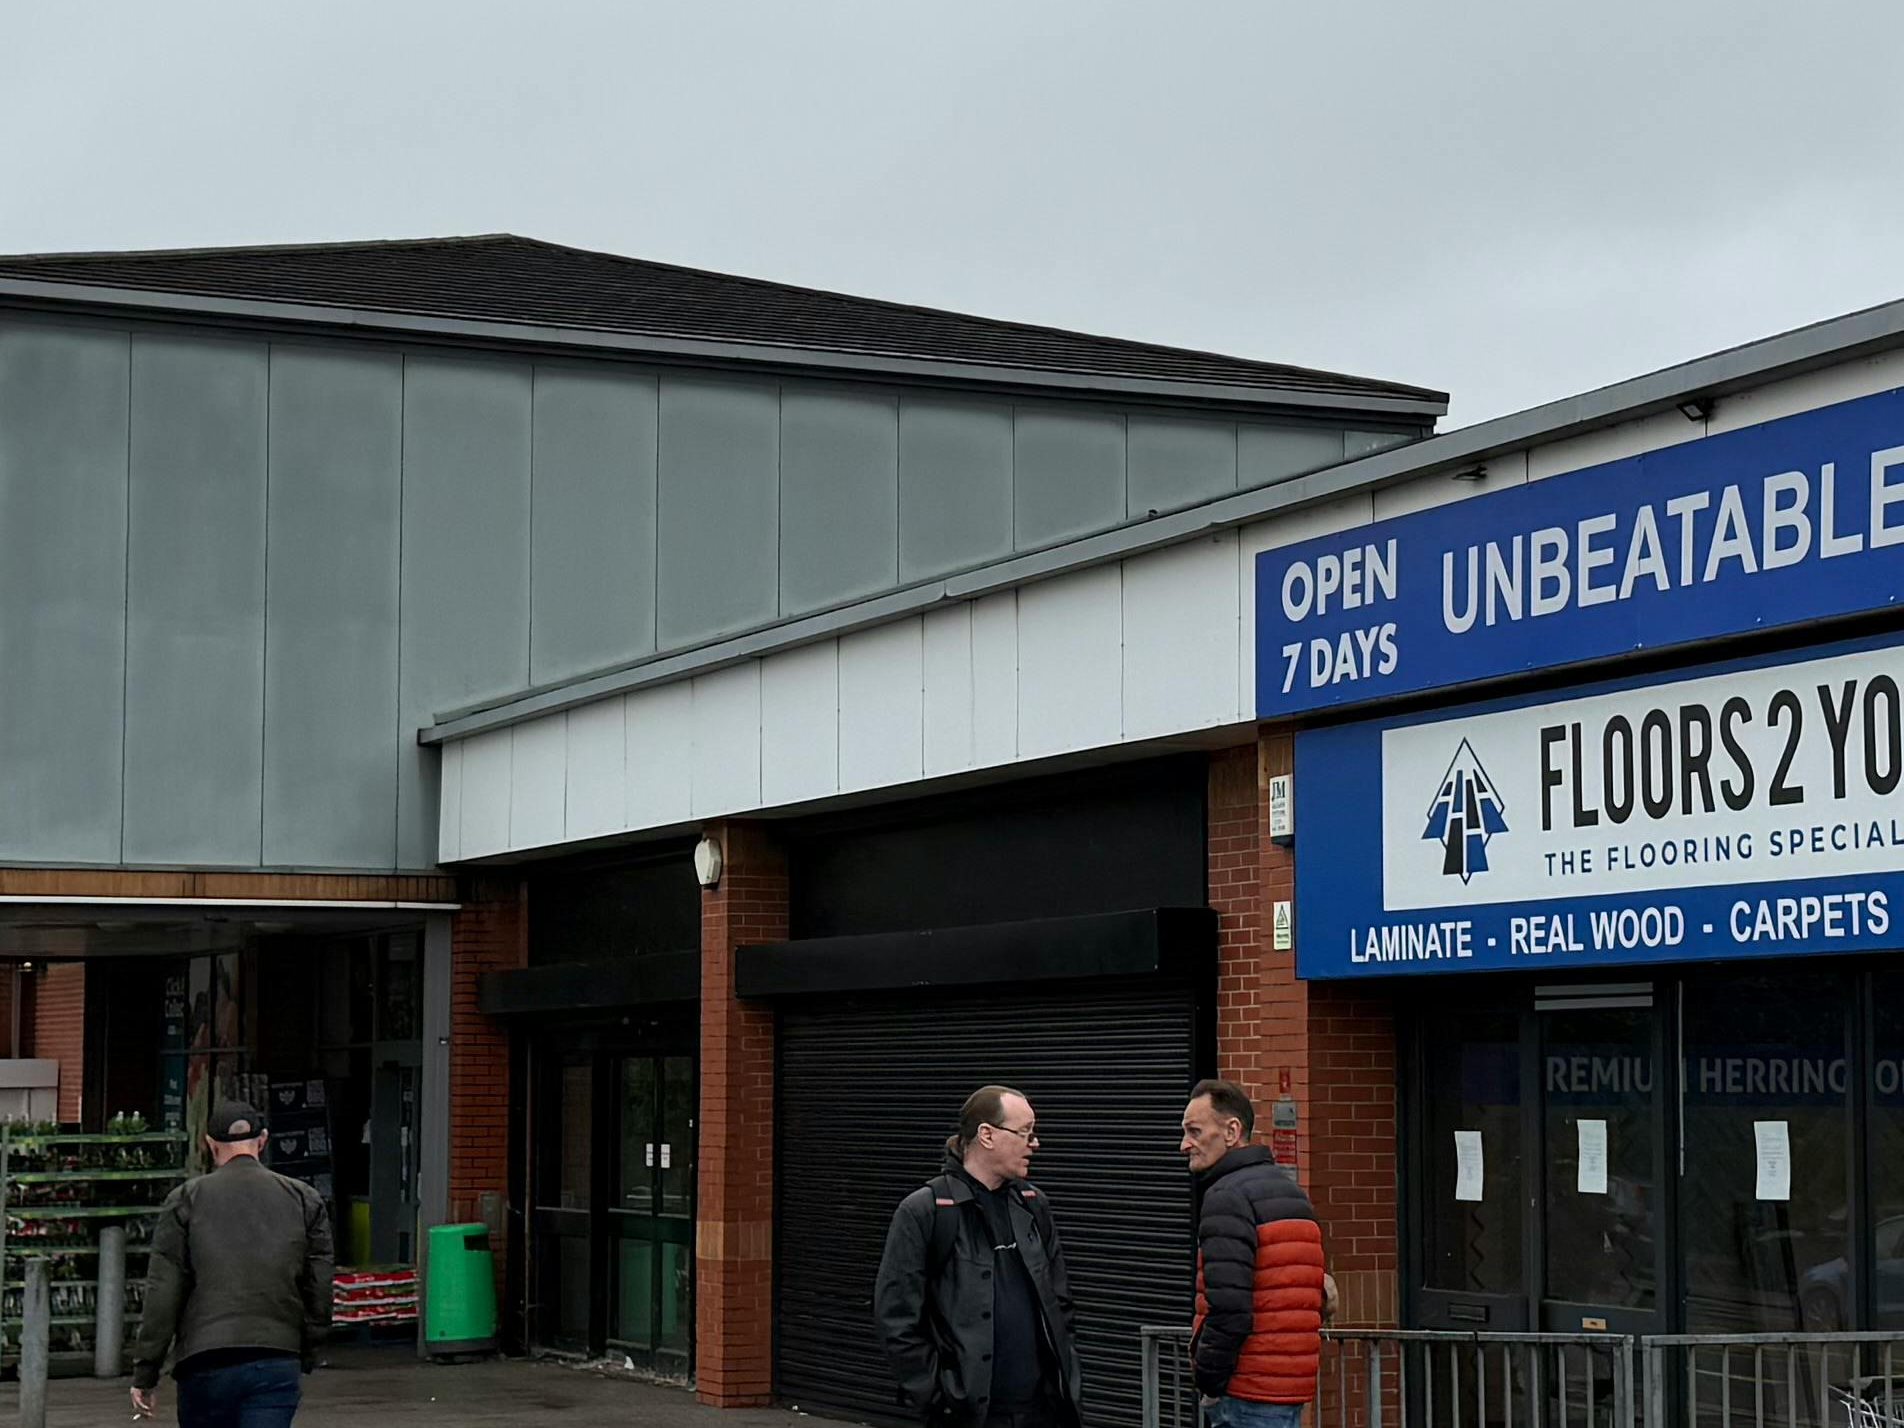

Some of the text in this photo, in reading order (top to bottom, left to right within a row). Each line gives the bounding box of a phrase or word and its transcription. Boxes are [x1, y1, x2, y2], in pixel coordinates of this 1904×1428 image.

[1281, 538, 1397, 622] OPEN
[1281, 622, 1398, 694] 7 DAYS
[1544, 849, 1593, 876] THE
[1607, 833, 1753, 872] FLOORING
[1349, 920, 1473, 963] LAMINATE
[1510, 913, 1584, 955] REAL
[1588, 905, 1685, 949] WOOD
[1730, 890, 1889, 943] CARPETS
[1545, 1056, 1688, 1093] REMIU
